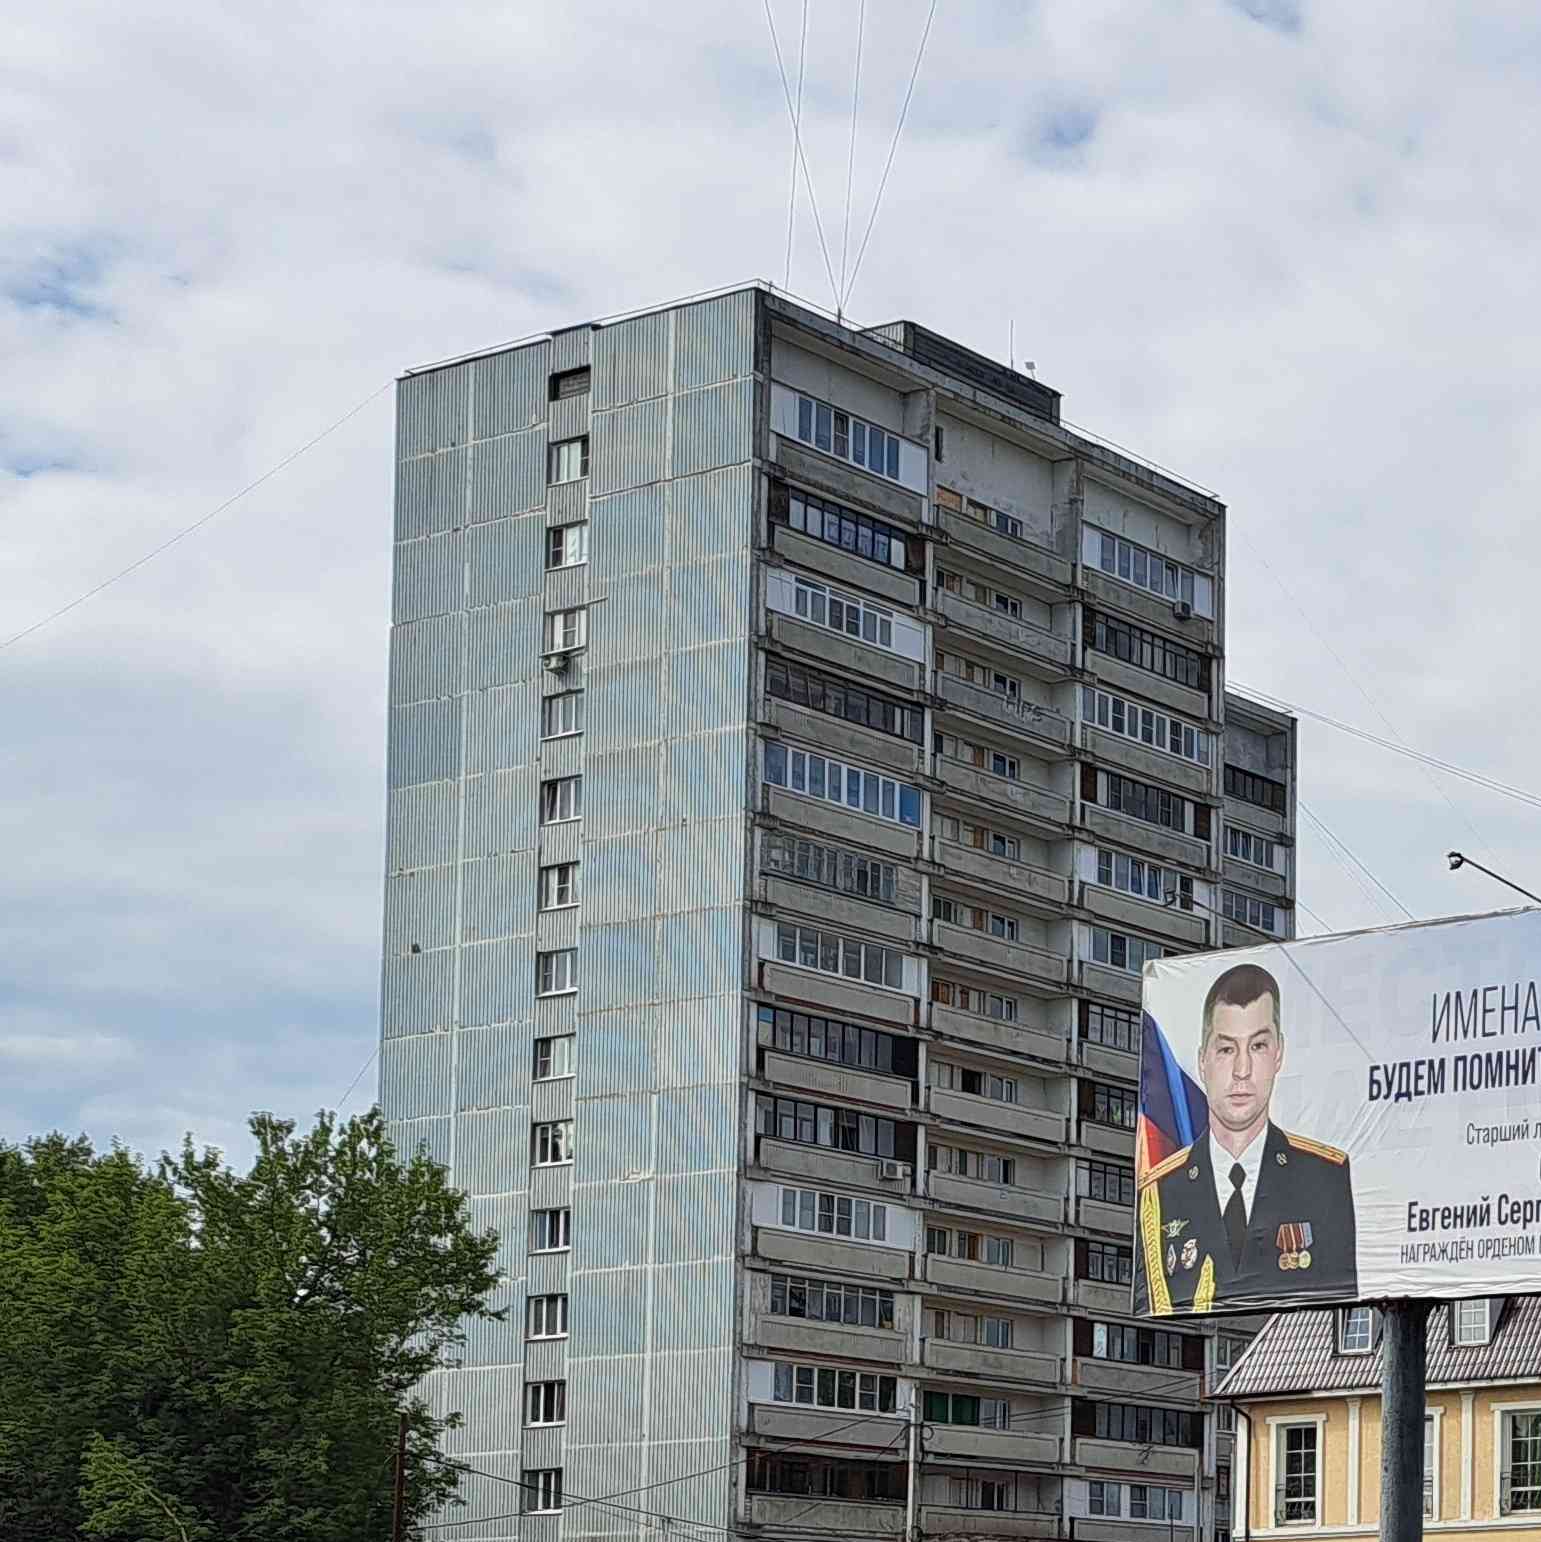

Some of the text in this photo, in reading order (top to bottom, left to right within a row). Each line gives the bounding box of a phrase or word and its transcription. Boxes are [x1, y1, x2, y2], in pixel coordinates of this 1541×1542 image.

[1430, 981, 1541, 1044] ИМЕНА
[1368, 1059, 1447, 1102] БУДЕМ
[1465, 1120, 1530, 1147] Старший
[1407, 1196, 1491, 1233] Евгений
[1478, 1236, 1536, 1261] ОРДЕНОМ
